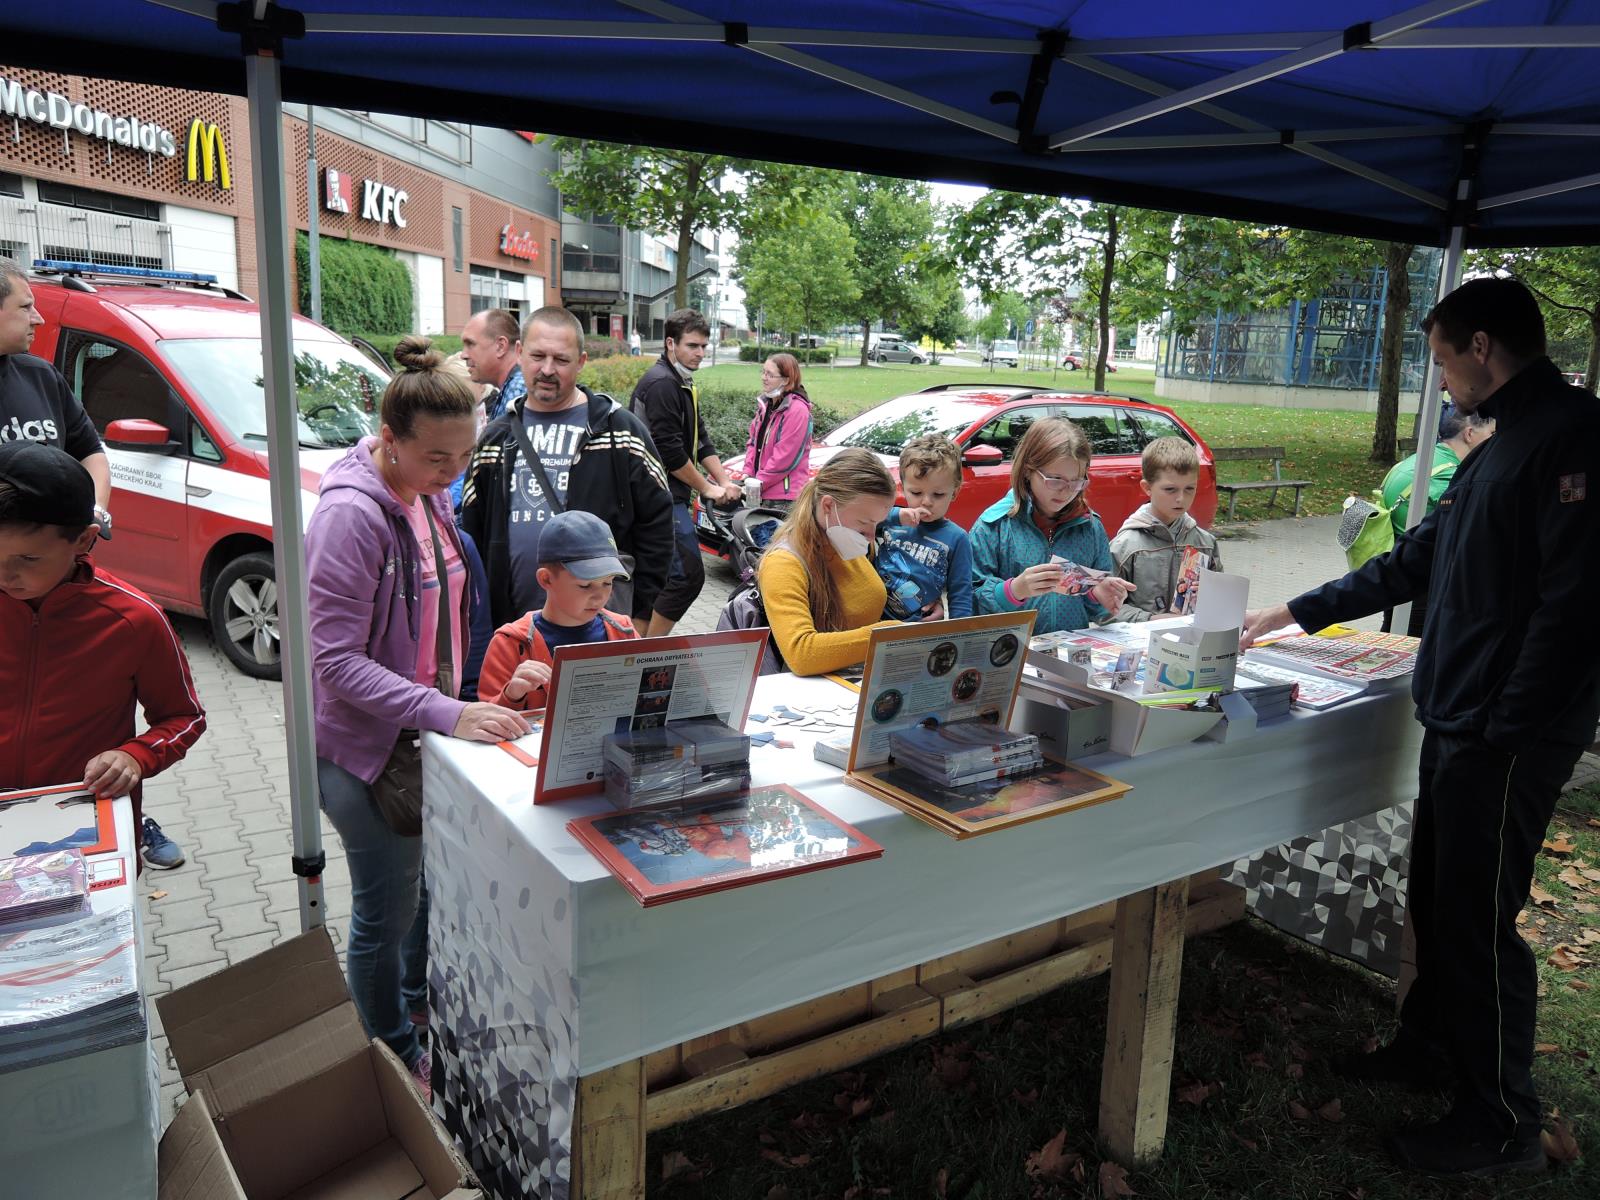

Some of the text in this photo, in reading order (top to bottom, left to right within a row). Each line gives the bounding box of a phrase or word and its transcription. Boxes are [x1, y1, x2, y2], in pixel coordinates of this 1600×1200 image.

[0, 77, 176, 158] McDonald's
[362, 178, 409, 228] KFC
[0, 416, 58, 443] das
[636, 656, 664, 665] OCHRANA
